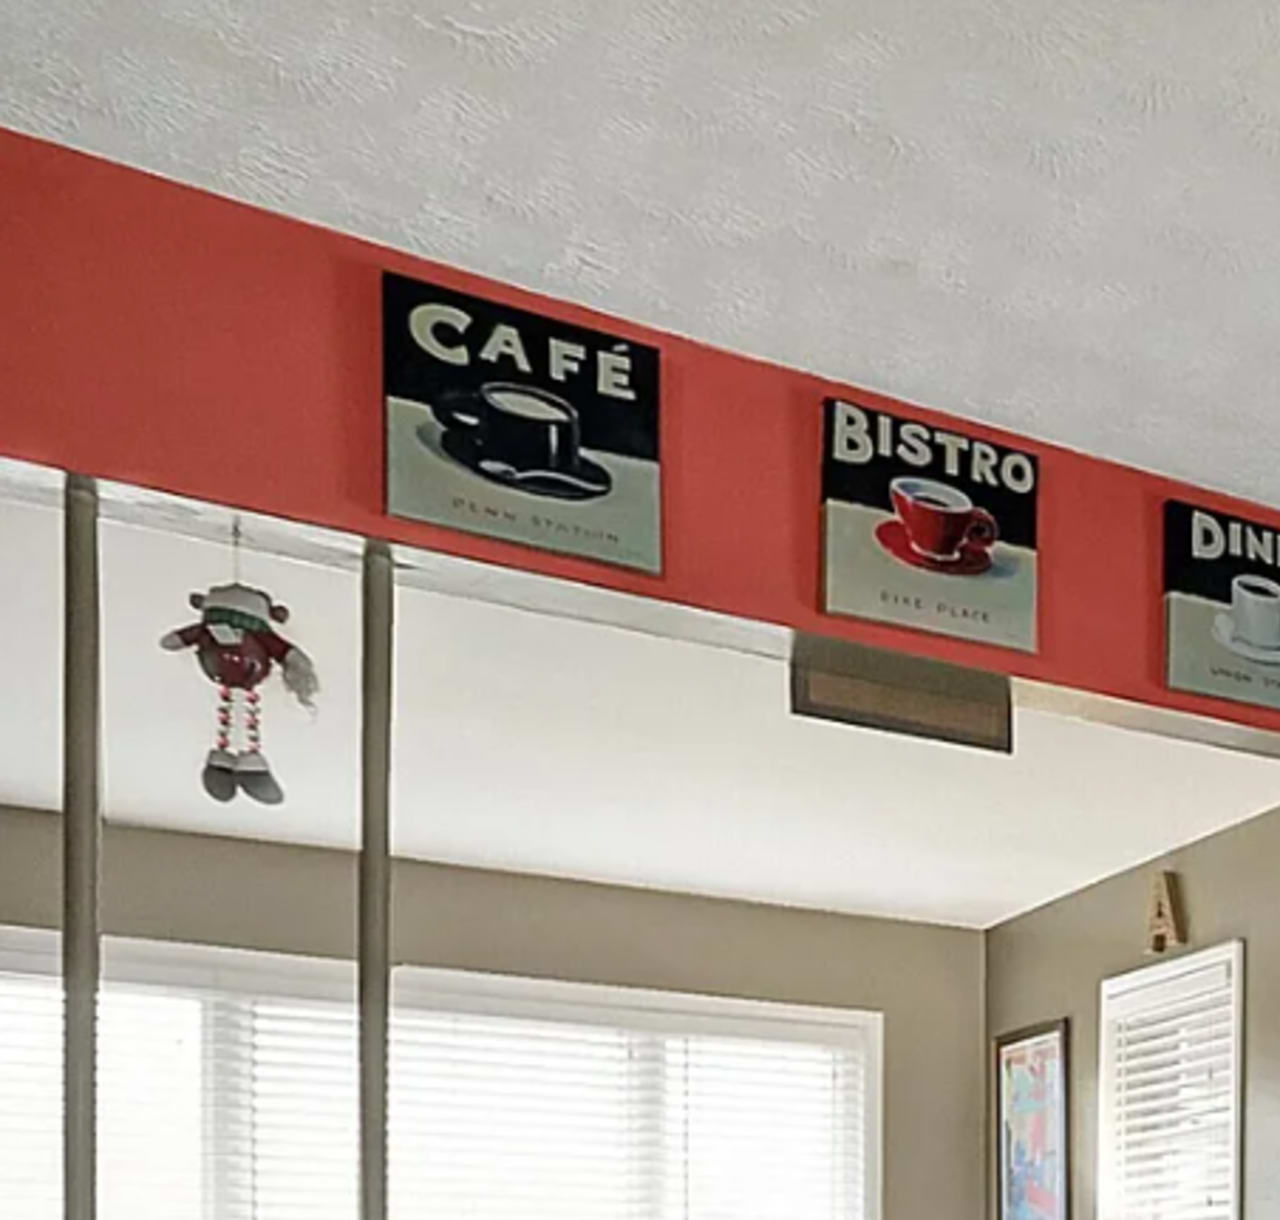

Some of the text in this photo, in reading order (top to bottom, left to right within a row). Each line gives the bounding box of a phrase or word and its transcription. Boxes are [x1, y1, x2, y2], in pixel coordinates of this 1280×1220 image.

[408, 302, 636, 401] CAFÉ
[832, 400, 1035, 494] BISTRO
[936, 599, 990, 624] PLACE
